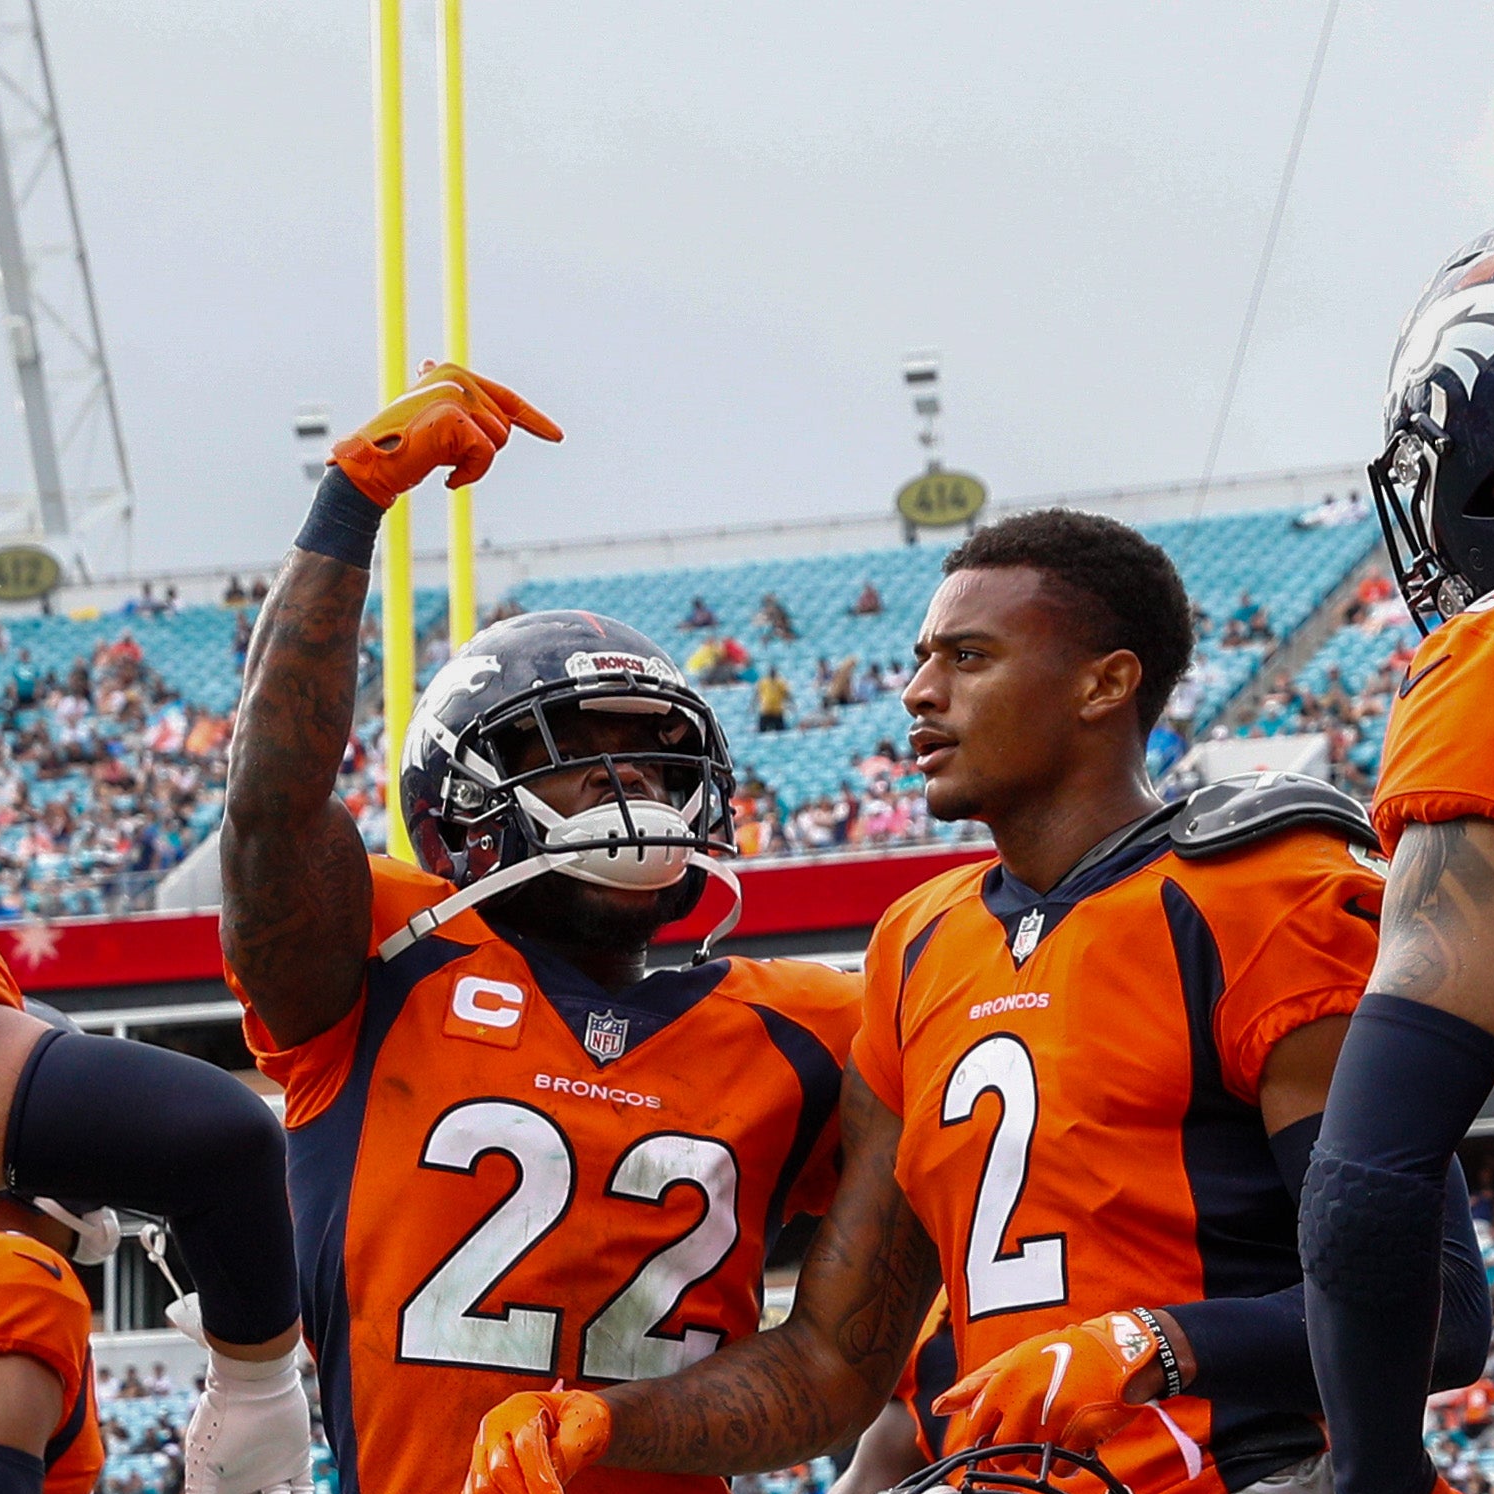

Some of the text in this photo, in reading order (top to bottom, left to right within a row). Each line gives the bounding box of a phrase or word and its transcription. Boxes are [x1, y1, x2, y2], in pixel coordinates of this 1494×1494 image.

[592, 657, 645, 674] BRONCOS
[452, 975, 524, 1028] C
[969, 992, 1051, 1020] BRONCOS
[592, 1031, 620, 1053] NFL
[534, 1073, 662, 1110] BRONCOS
[939, 1031, 1069, 1324] 2
[396, 1096, 741, 1383] 22
[1156, 1335, 1176, 1368] OVER
